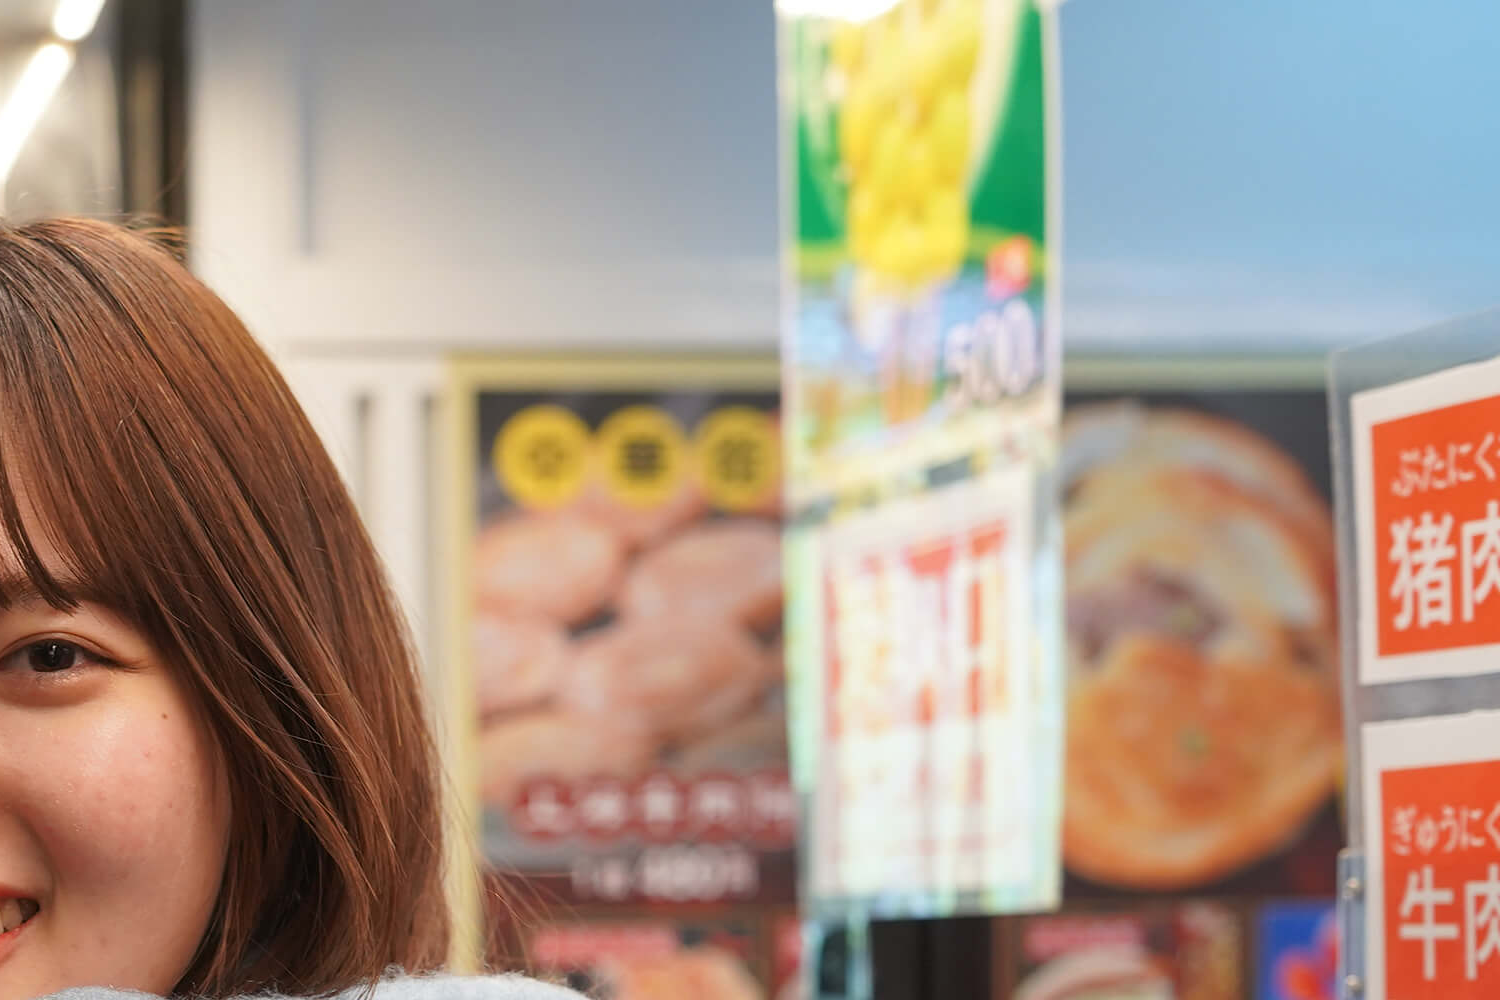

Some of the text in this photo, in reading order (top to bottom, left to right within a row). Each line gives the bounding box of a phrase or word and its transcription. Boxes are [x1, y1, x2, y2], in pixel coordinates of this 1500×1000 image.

[1391, 432, 1500, 497] ぶたにく
[1399, 864, 1500, 981] 牛肉
